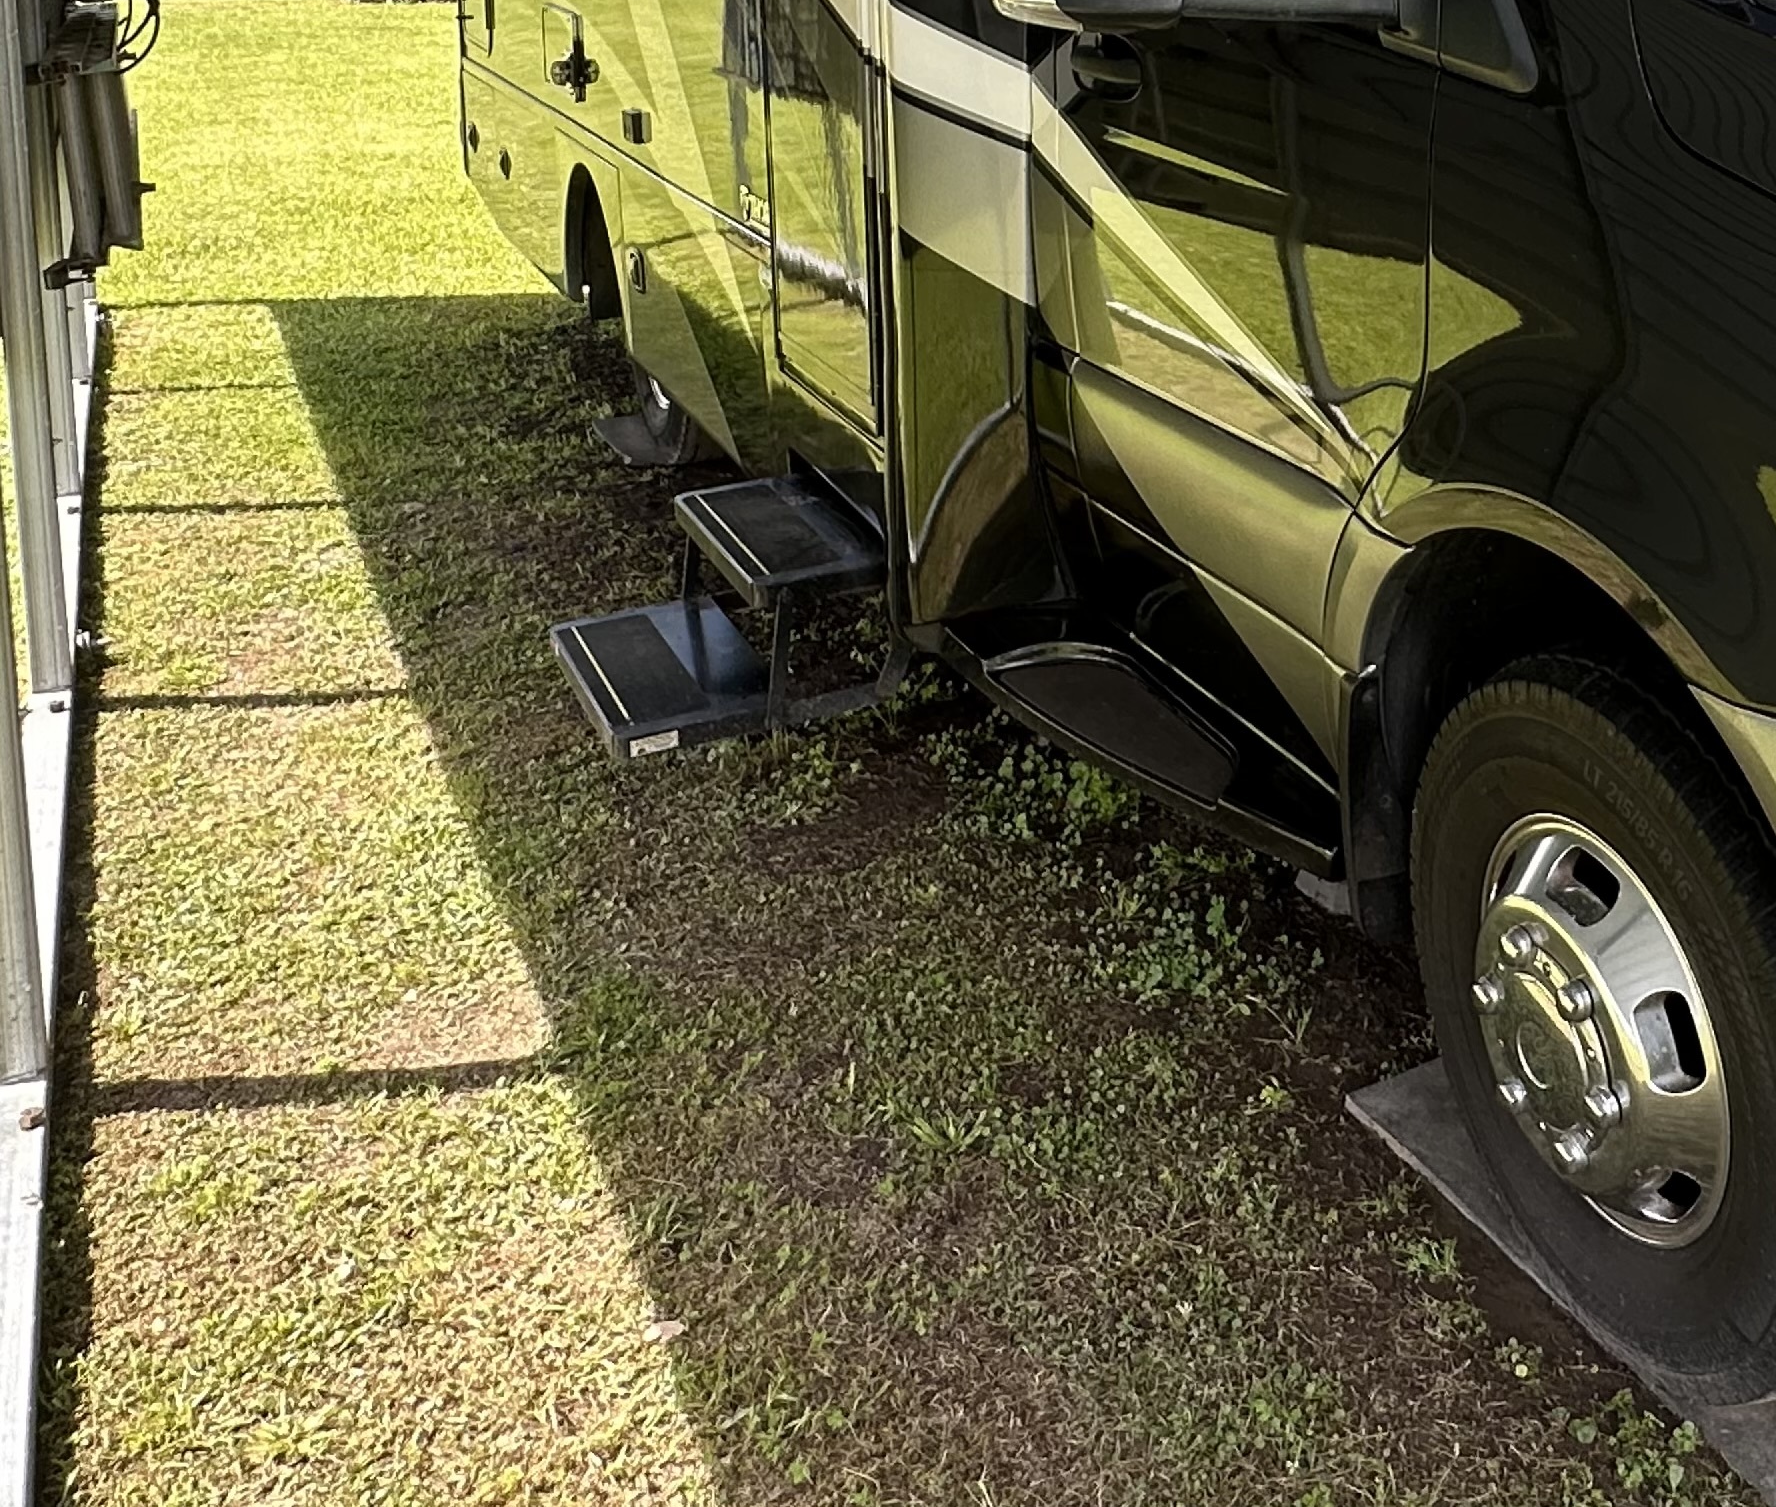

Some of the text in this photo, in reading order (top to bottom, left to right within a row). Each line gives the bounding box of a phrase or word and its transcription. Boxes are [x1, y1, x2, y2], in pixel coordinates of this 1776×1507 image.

[1583, 760, 1603, 788] LT
[1606, 782, 1659, 848] 215/85
[1672, 869, 1693, 901] 16
